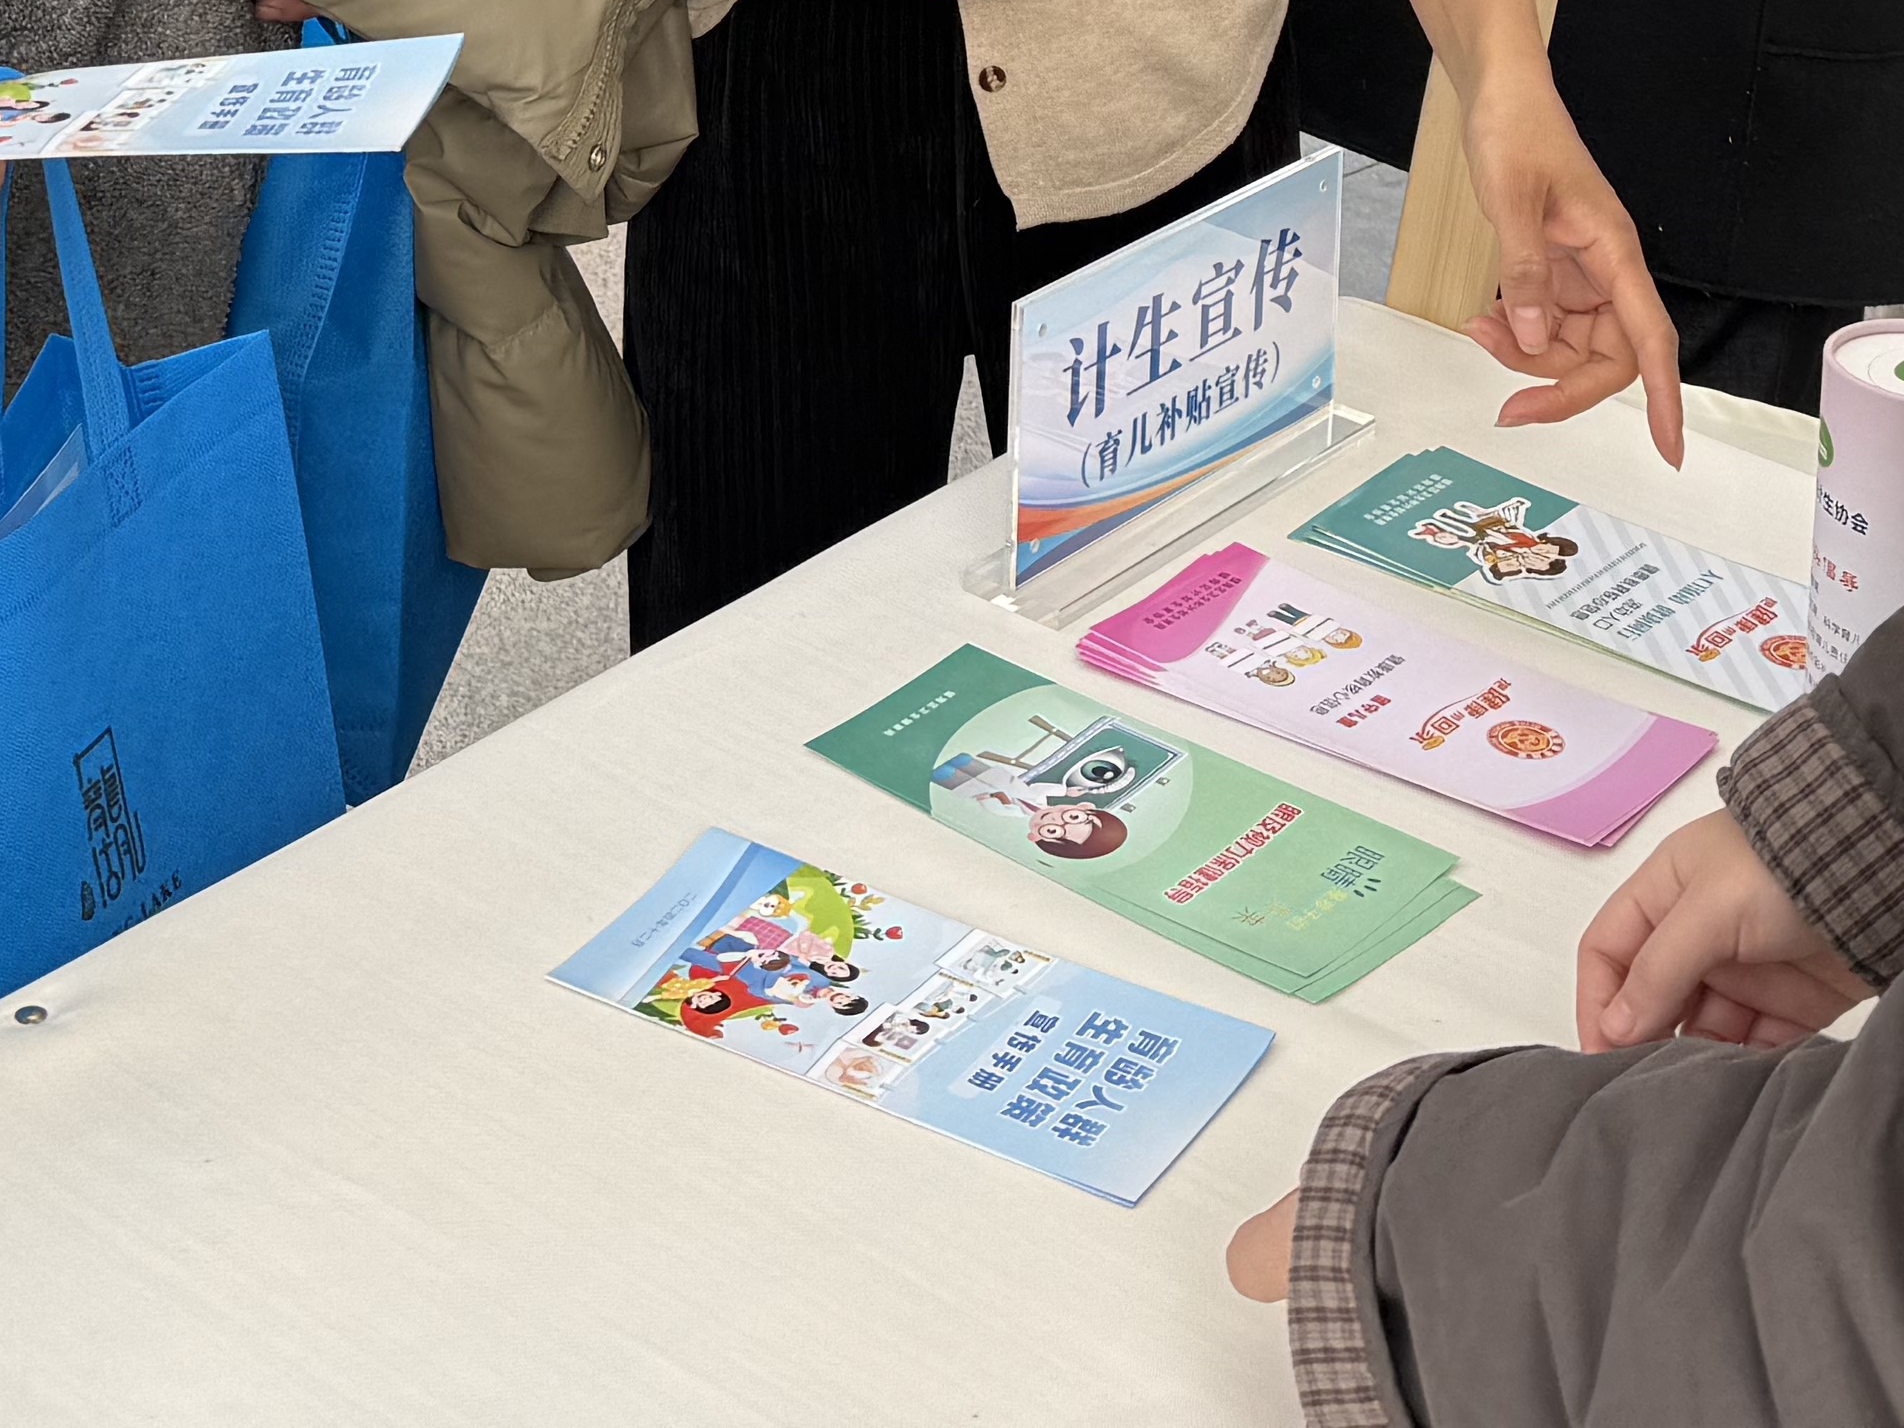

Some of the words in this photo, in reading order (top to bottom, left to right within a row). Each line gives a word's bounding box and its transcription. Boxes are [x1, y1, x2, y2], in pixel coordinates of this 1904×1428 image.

[1062, 227, 1303, 427] 计生宣传
[1160, 801, 1303, 905] 眼及视力保健指导
[965, 1009, 1062, 1092] 宣传手册
[998, 1010, 1133, 1130] 生育政策
[1048, 1026, 1183, 1149] 育龄人群
